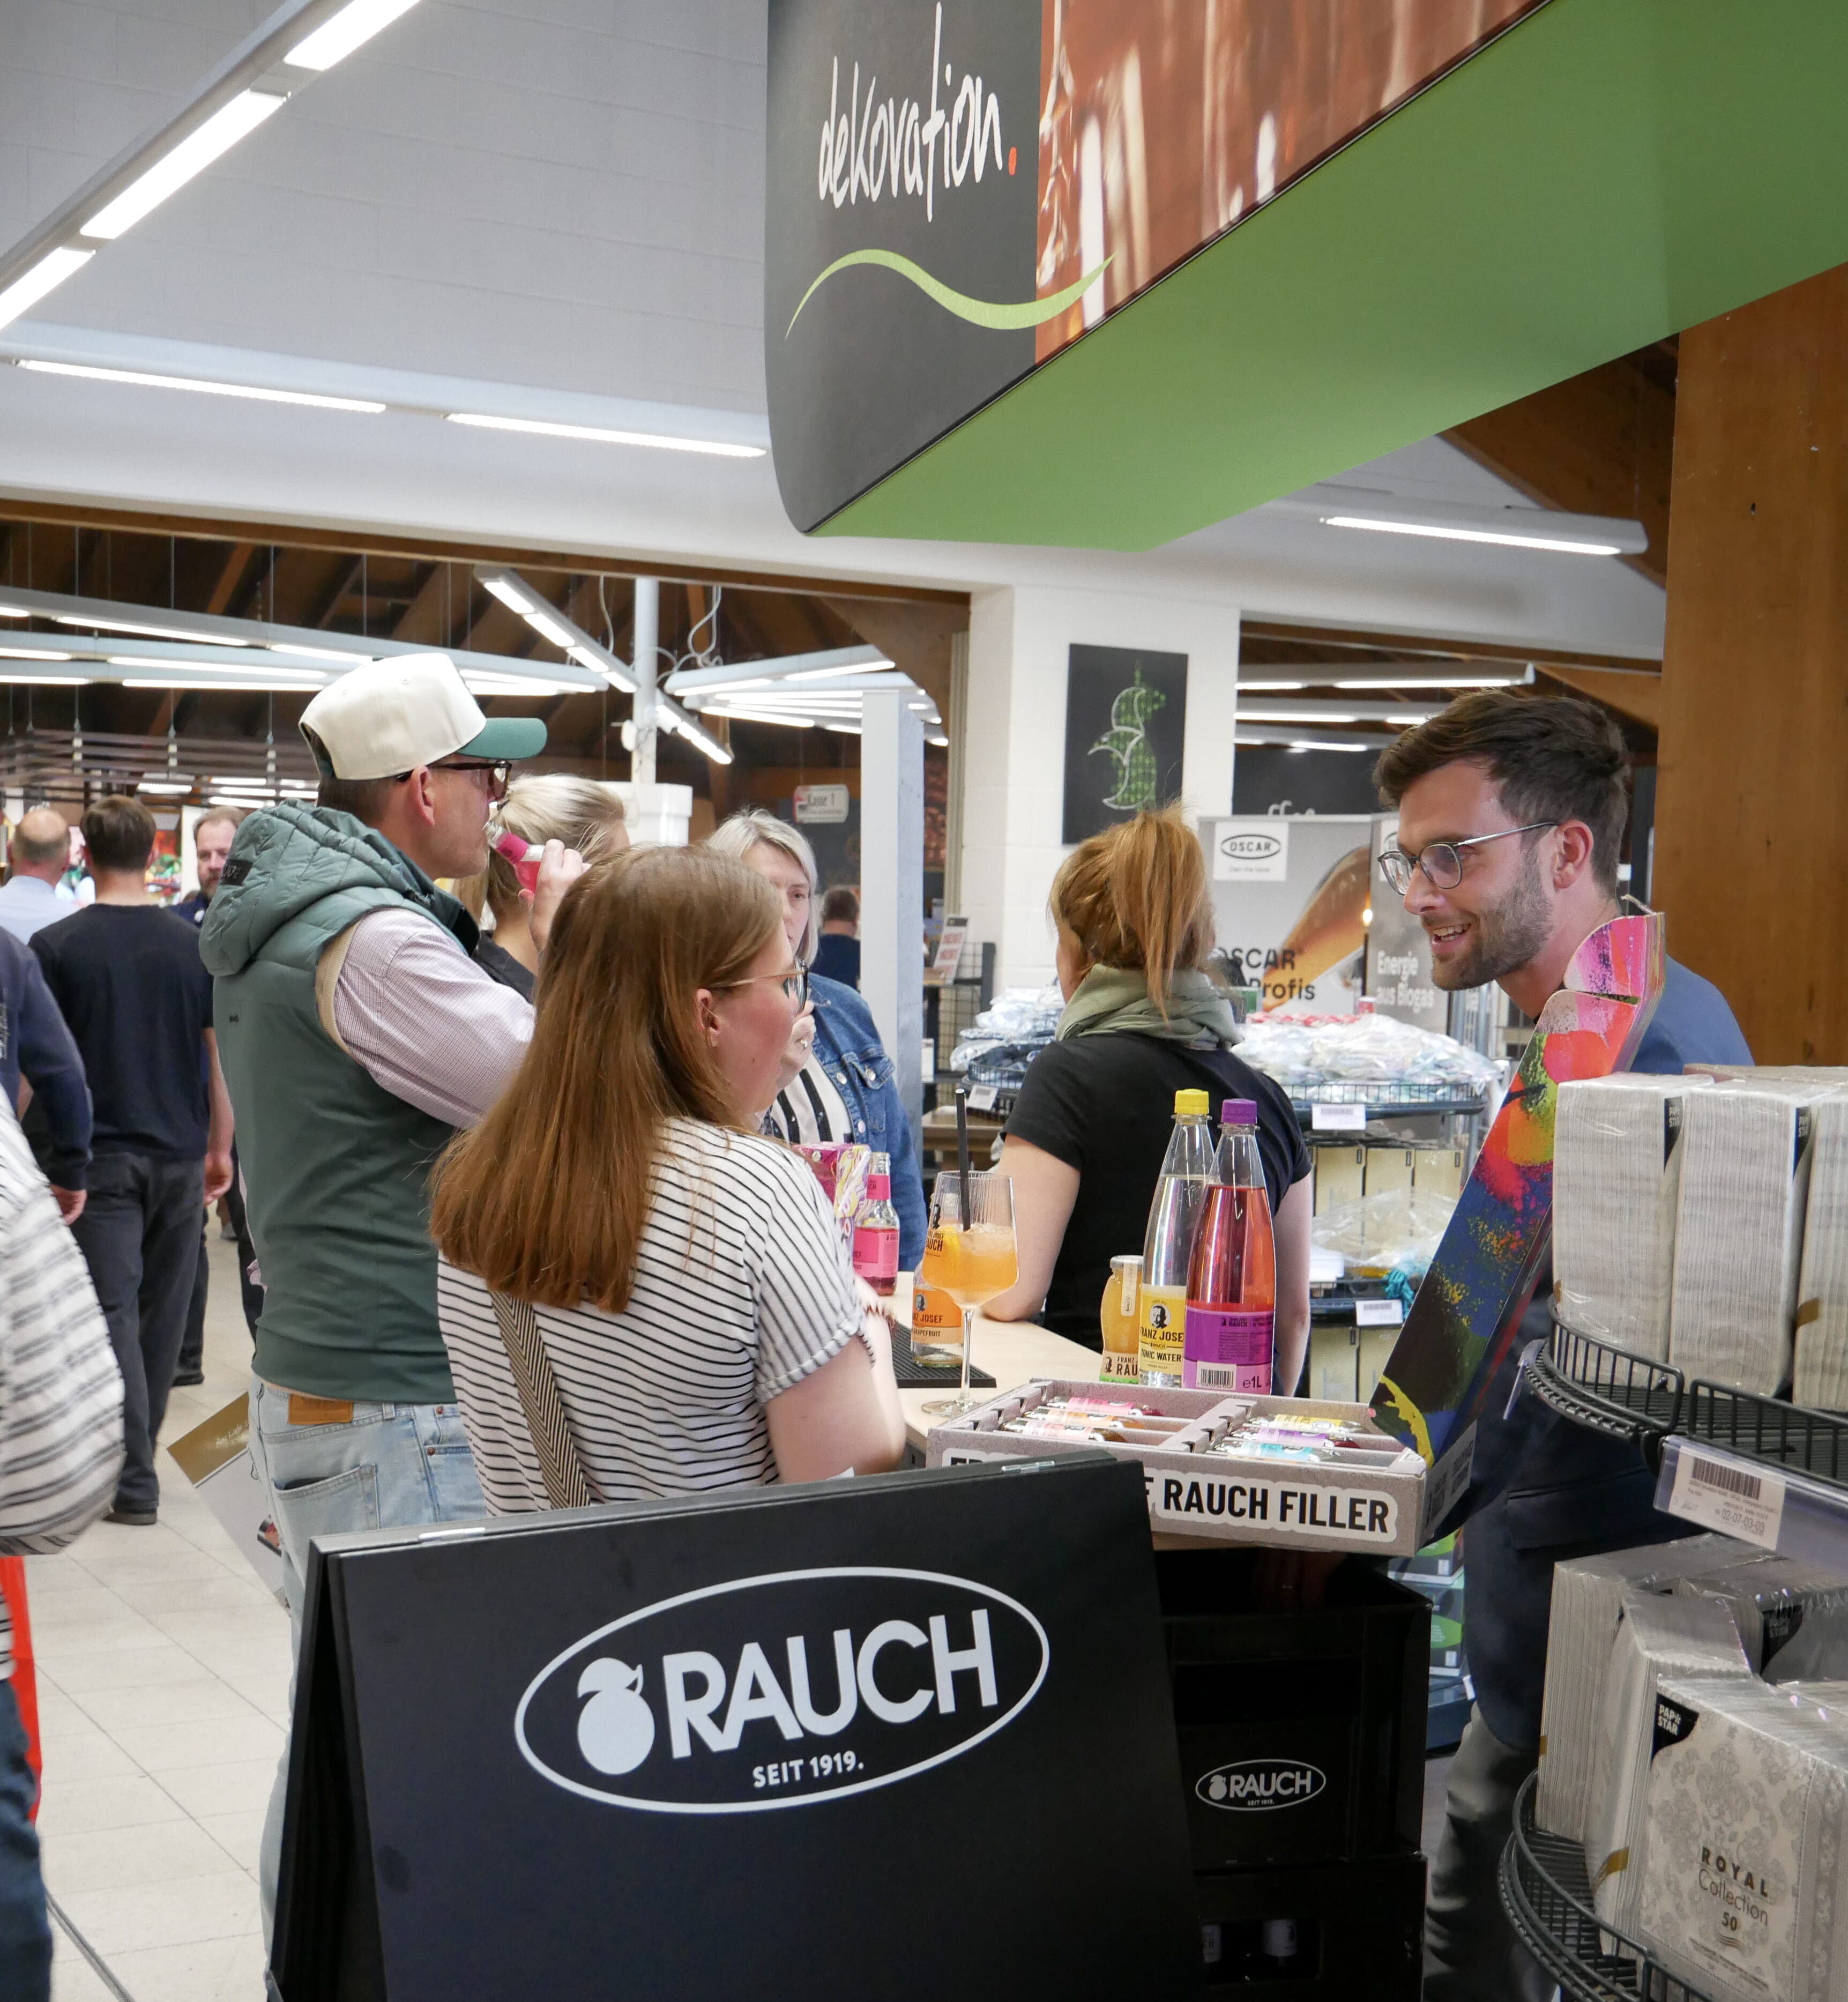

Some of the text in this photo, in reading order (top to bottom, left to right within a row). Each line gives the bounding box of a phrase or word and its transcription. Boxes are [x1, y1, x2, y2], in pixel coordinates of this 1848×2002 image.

[1230, 842, 1271, 852] OSCAR
[1377, 950, 1419, 981] Energie
[1376, 982, 1434, 1014] aus Biogas
[920, 1314, 943, 1323] JOSEF
[1141, 1348, 1182, 1363] TONIC WATER
[1164, 1478, 1269, 1521] RAUCH
[1279, 1490, 1389, 1533] FILLER
[661, 1609, 998, 1760] RAUCH
[1658, 1715, 1678, 1735] STAR
[752, 1750, 865, 1789] SEIT 1919.
[1229, 1770, 1312, 1798] RAUCH
[1701, 1845, 1768, 1897] ROYAL
[1698, 1868, 1768, 1927] Collection
[1722, 1911, 1738, 1931] 50
